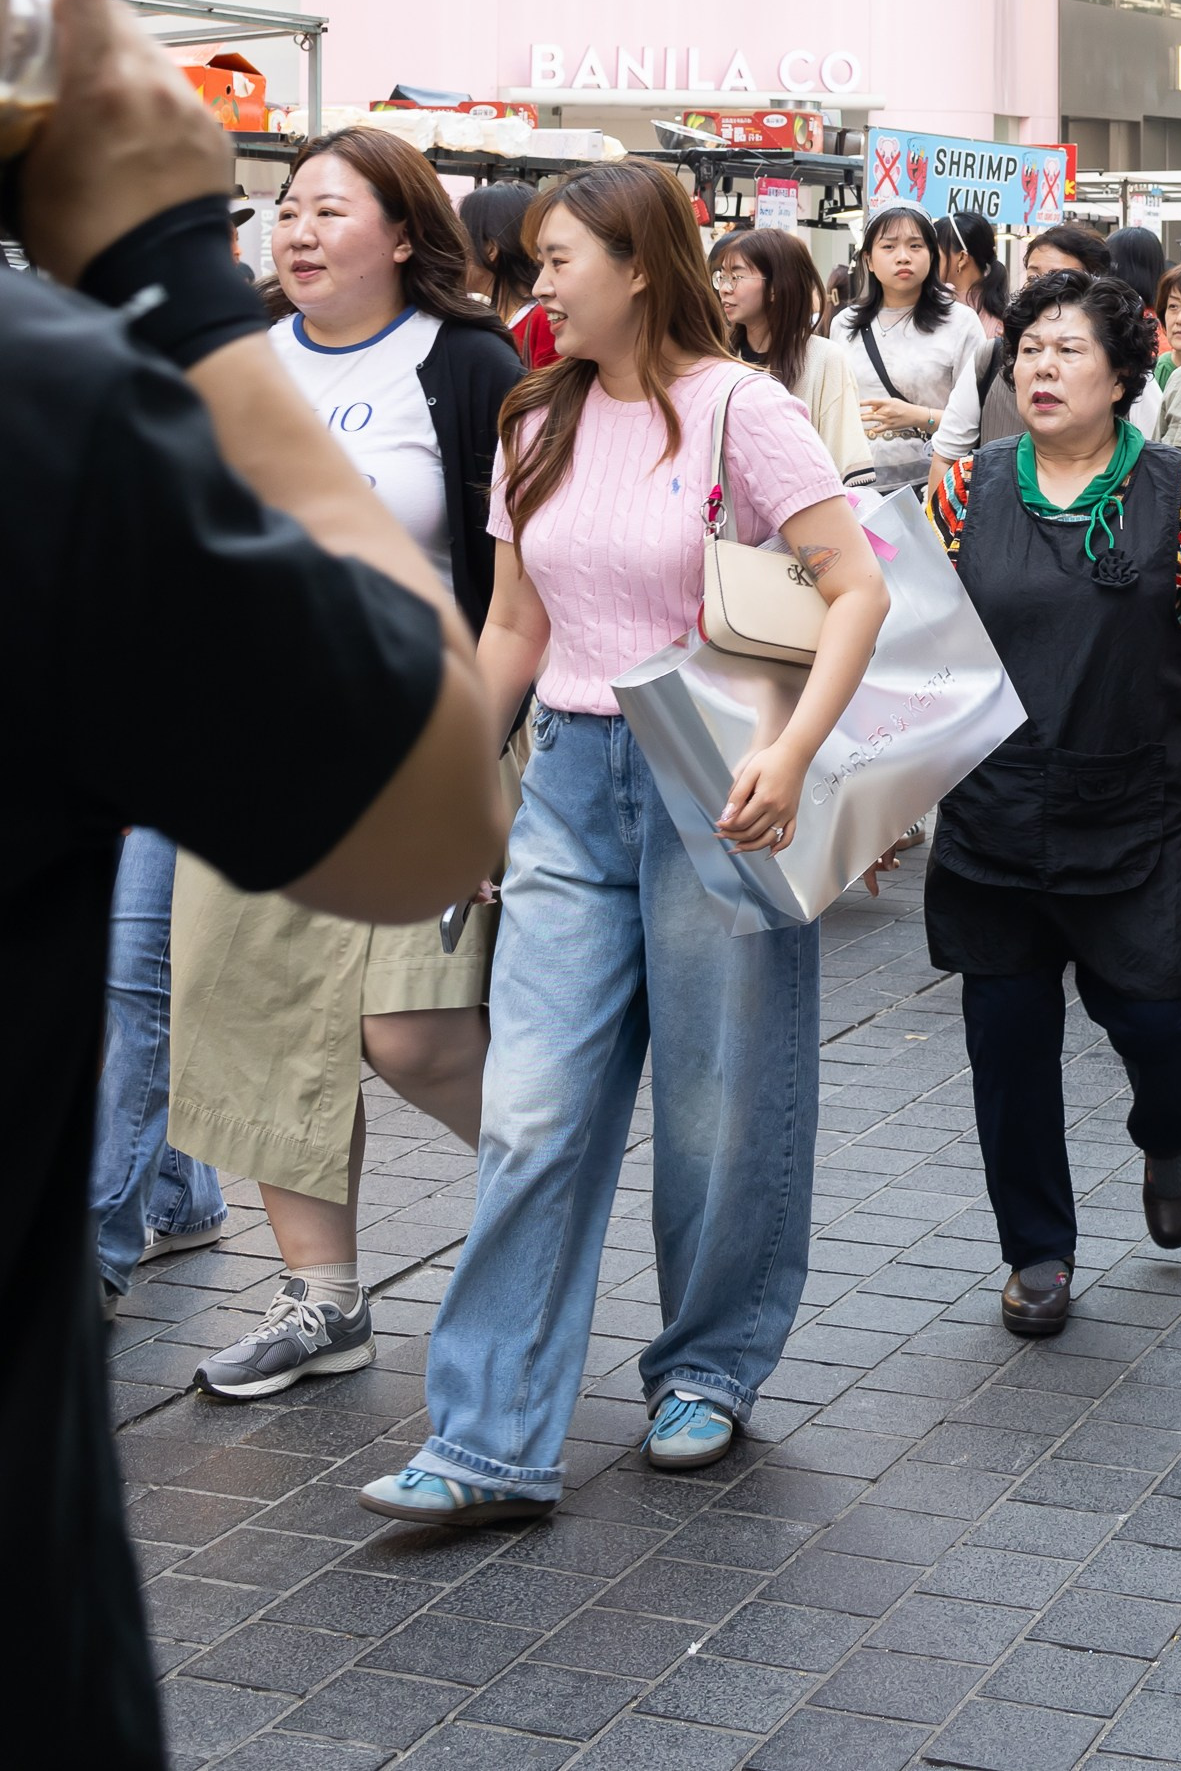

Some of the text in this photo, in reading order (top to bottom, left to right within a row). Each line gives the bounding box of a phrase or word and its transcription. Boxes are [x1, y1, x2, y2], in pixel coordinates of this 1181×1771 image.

[531, 43, 862, 94] BANILA CO
[934, 147, 1018, 183] SHRIMP
[948, 187, 1001, 217] KING
[810, 665, 957, 806] CHARLES & KEITH
